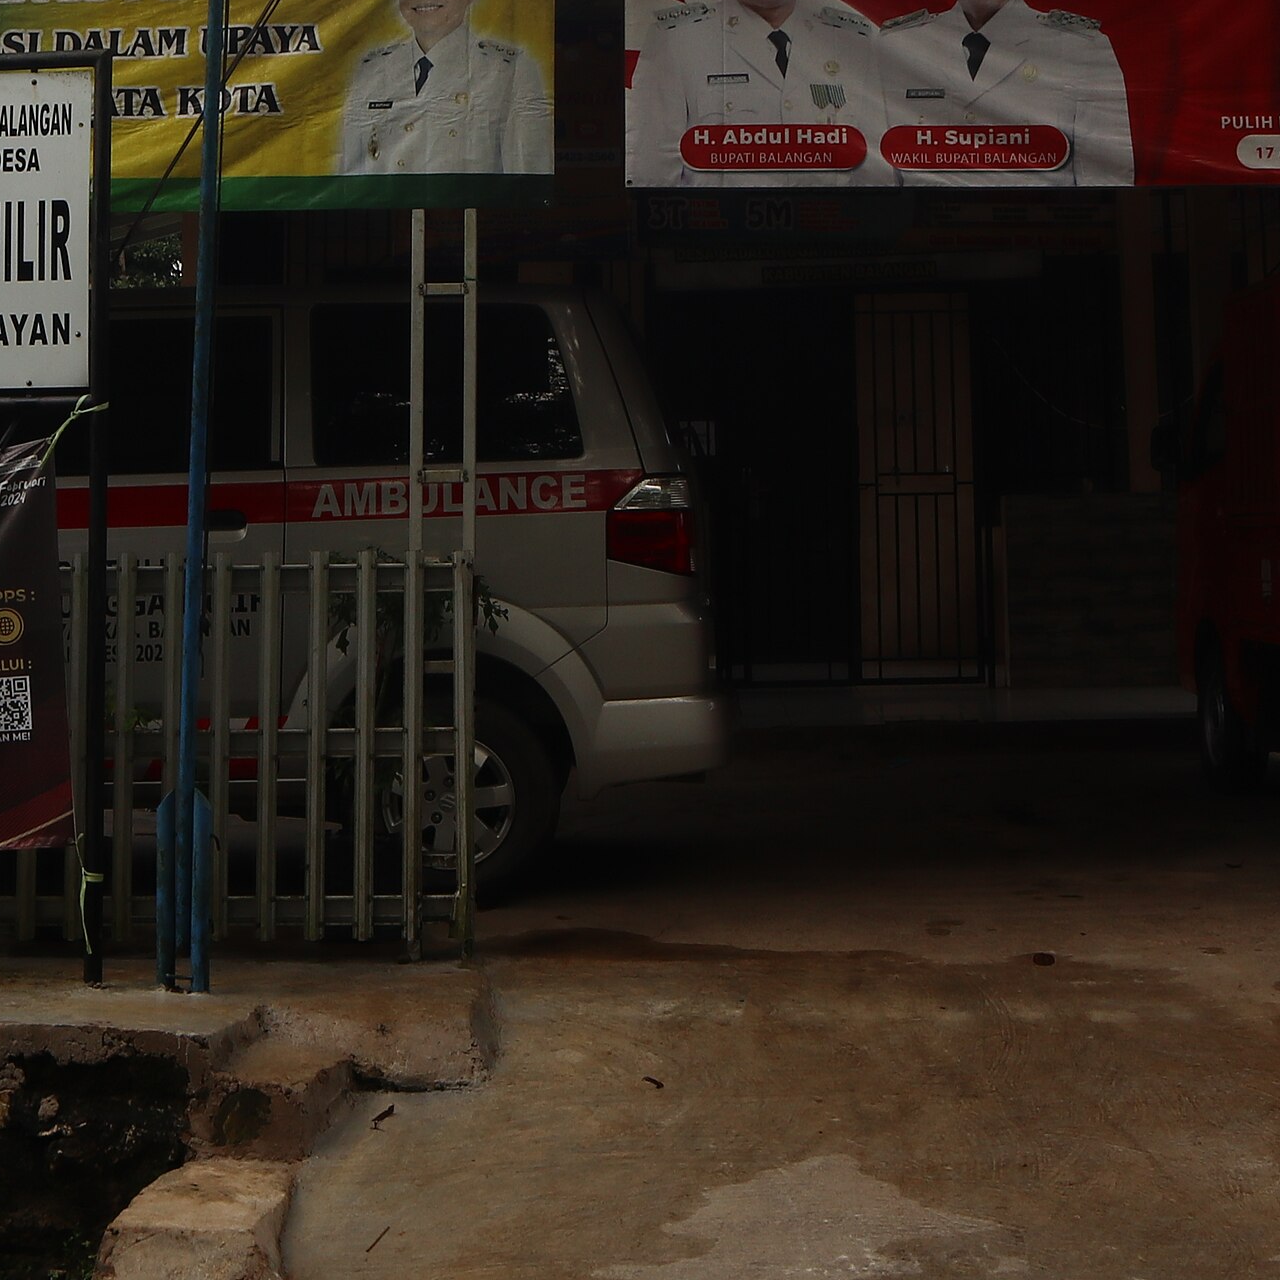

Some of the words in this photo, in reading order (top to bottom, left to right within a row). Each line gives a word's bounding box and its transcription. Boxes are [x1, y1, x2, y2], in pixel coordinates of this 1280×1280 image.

[55, 28, 187, 57] DALAM
[1221, 115, 1273, 130] PULIH
[694, 129, 716, 145] H.
[721, 128, 791, 145] Abdul
[797, 127, 848, 144] Hadi
[916, 130, 939, 145] H.
[944, 129, 1030, 149] Supiani
[710, 152, 756, 165] BUPATI
[759, 152, 832, 164] BALANGAN
[891, 153, 931, 165] WAKIL
[935, 153, 980, 165] BUPATI
[984, 152, 1057, 164] BALANGAN
[1256, 147, 1274, 159] 17
